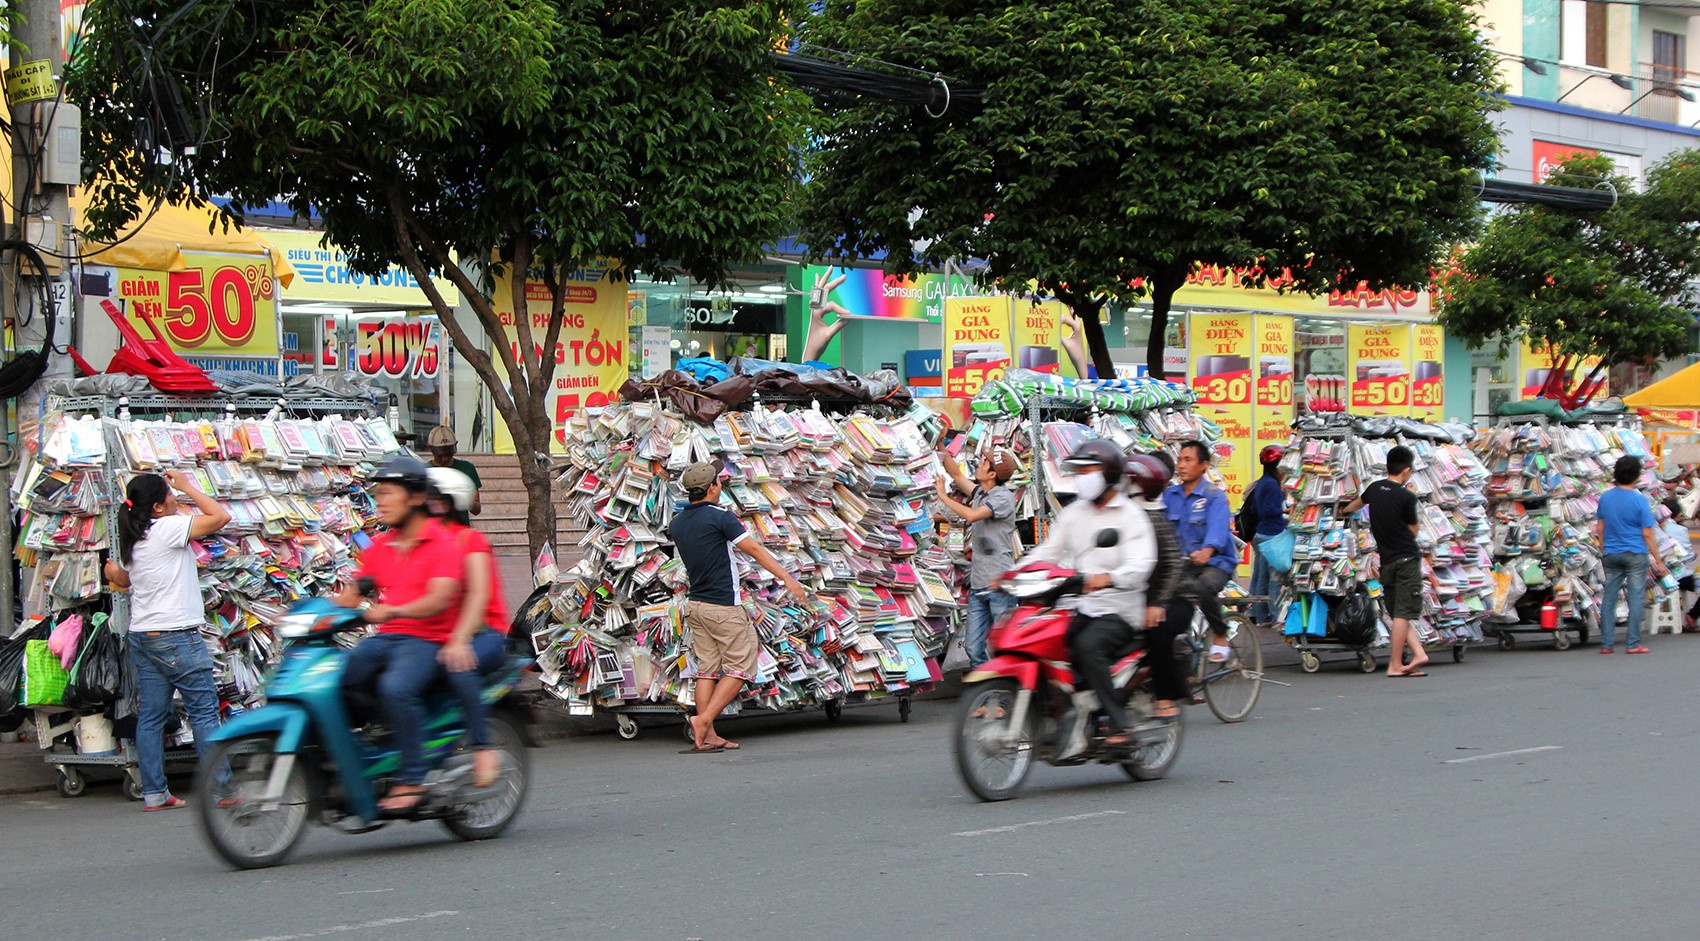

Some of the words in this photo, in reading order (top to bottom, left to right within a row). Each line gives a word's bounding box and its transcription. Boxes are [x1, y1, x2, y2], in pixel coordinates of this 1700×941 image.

[121, 276, 160, 297] GIẢM
[882, 283, 922, 301] Samsung
[164, 265, 273, 348] 50%
[962, 304, 991, 314] HÀNG
[533, 314, 585, 328] PHNG
[684, 307, 738, 325] SOY
[961, 315, 990, 327] GIA
[954, 329, 1000, 342] DỤNG
[1206, 327, 1245, 342] ĐIỆN
[1265, 332, 1282, 341] GIA
[1364, 337, 1391, 347] GIA
[357, 321, 440, 378] 50%
[1261, 343, 1288, 355] DỤNG
[1358, 348, 1400, 360] DỤNG
